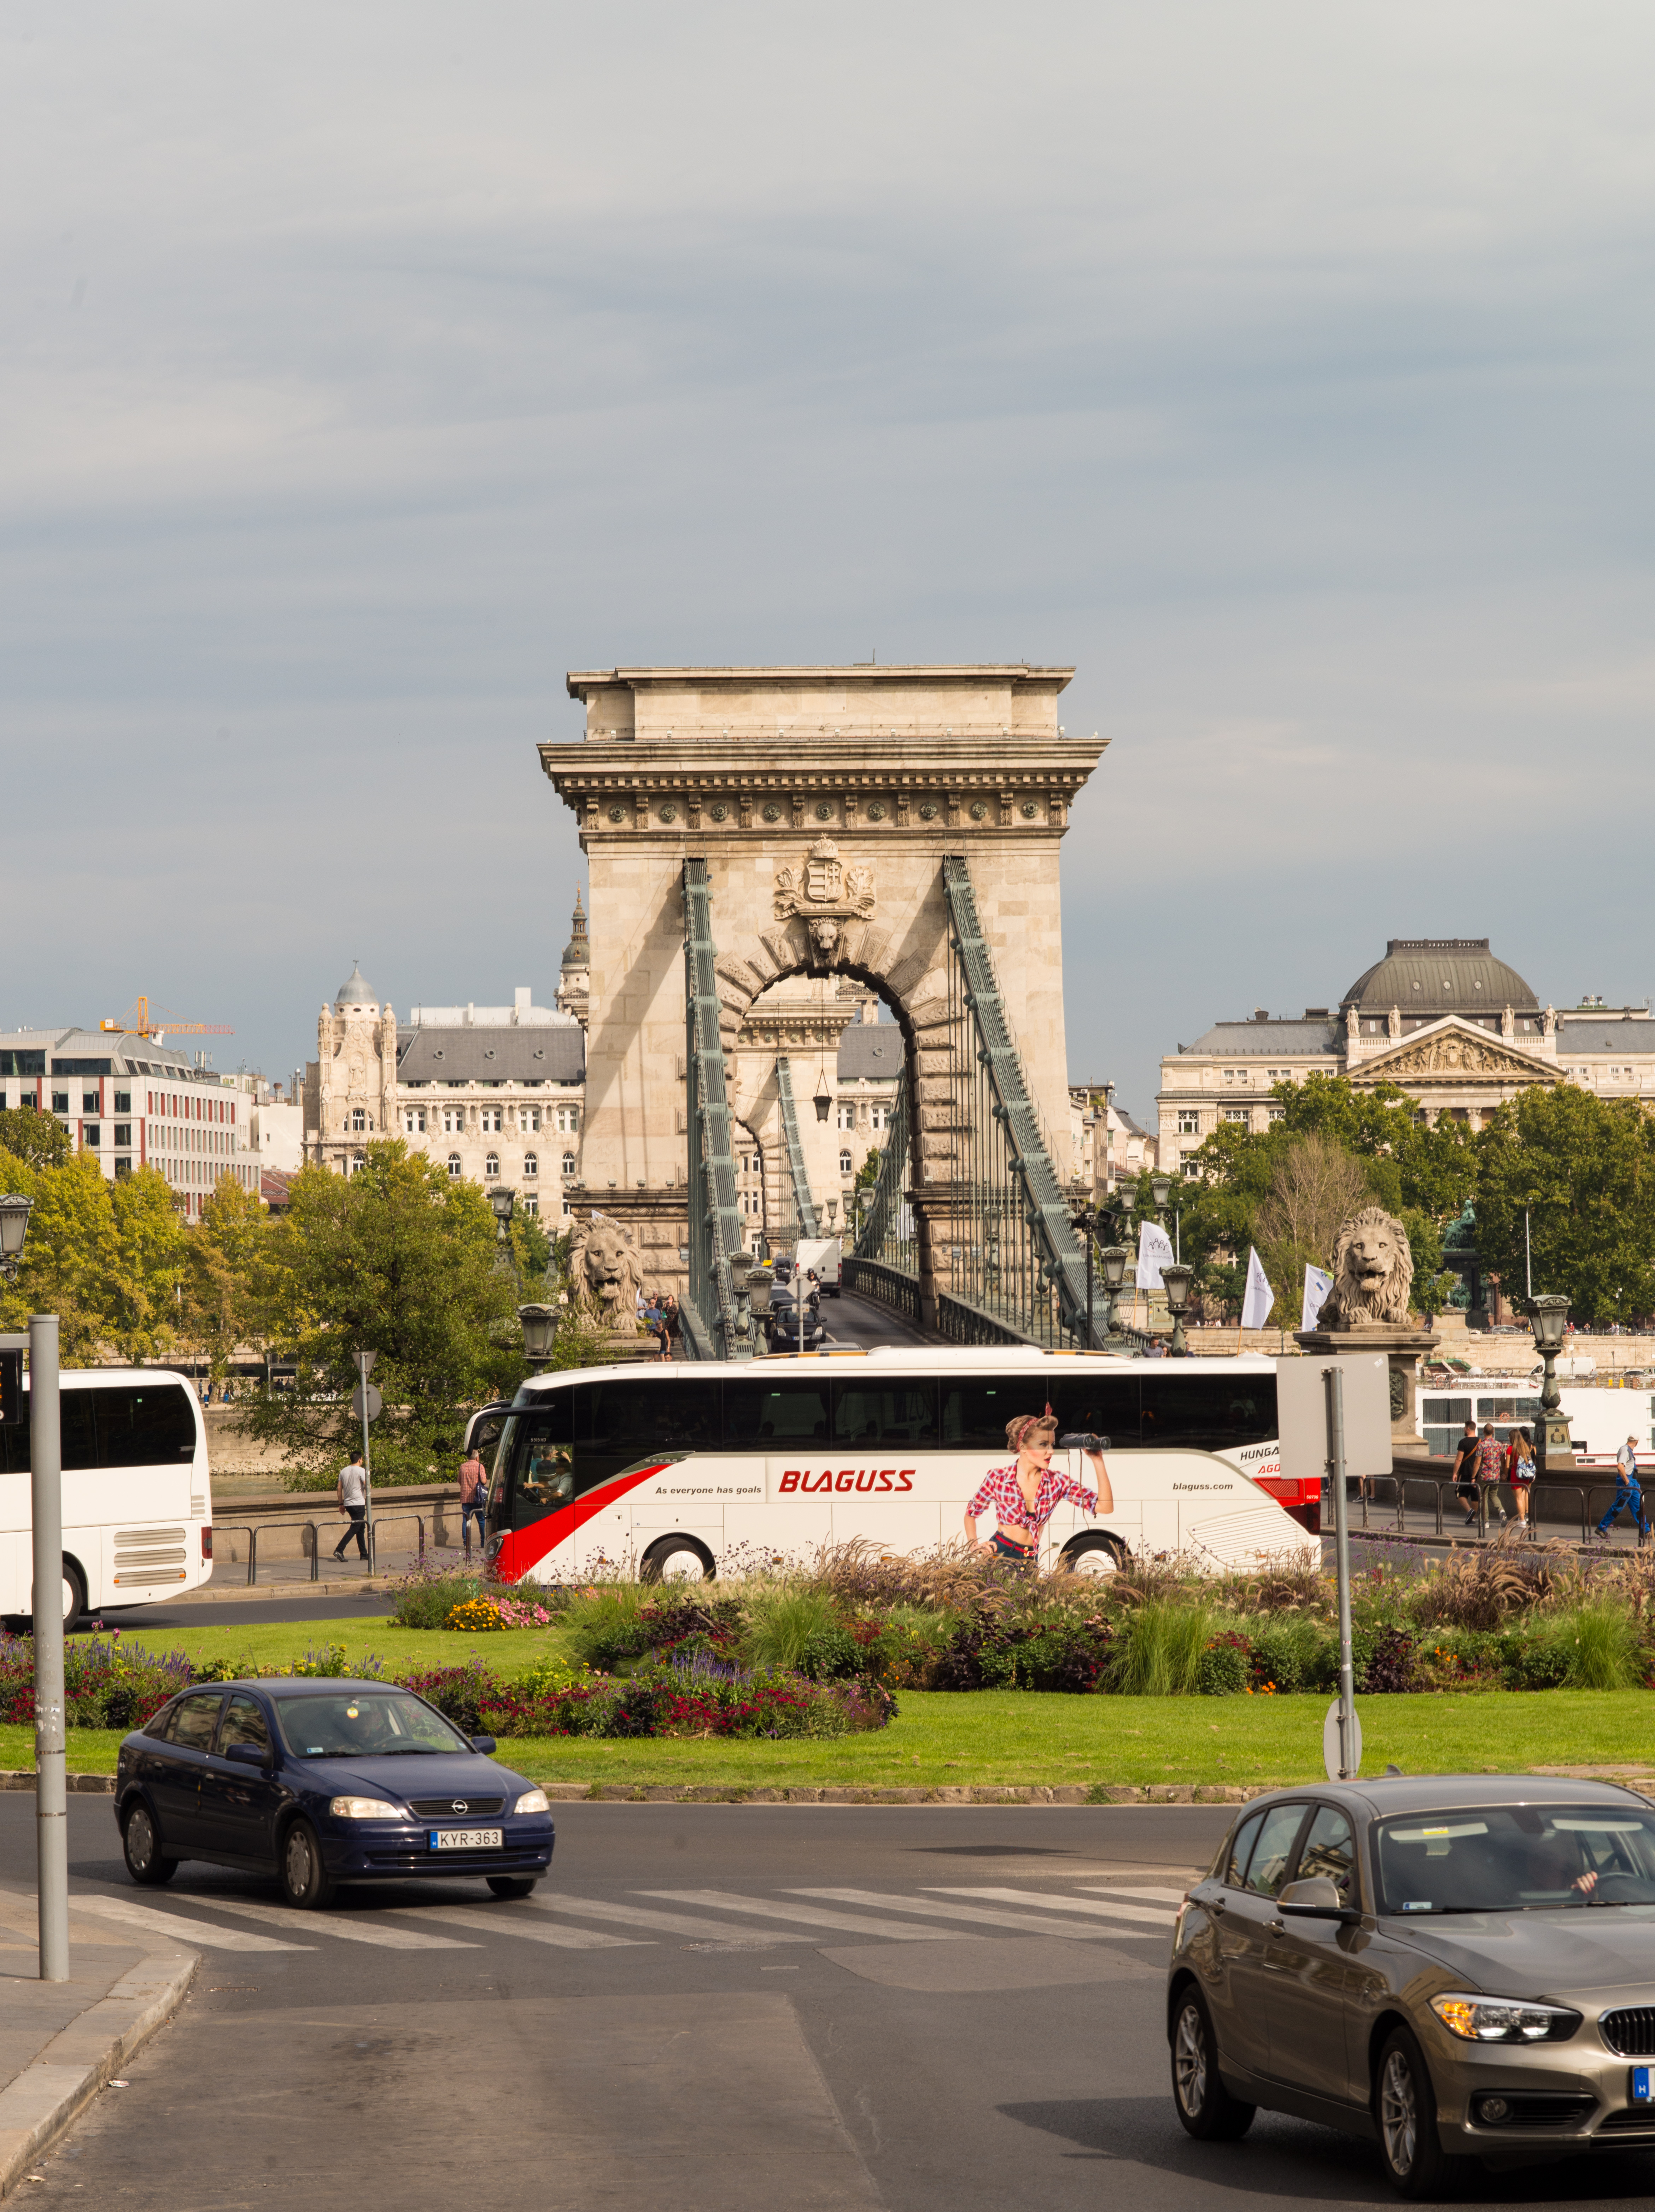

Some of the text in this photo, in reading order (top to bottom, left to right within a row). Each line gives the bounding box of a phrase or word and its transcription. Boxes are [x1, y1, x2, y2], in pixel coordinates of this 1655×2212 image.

[778, 1470, 916, 1492] BLAGUSS
[736, 1486, 761, 1495] goals
[1173, 1483, 1233, 1491] blaguss.com
[440, 1831, 498, 1846] KYR-363
[1638, 2084, 1646, 2094] H
